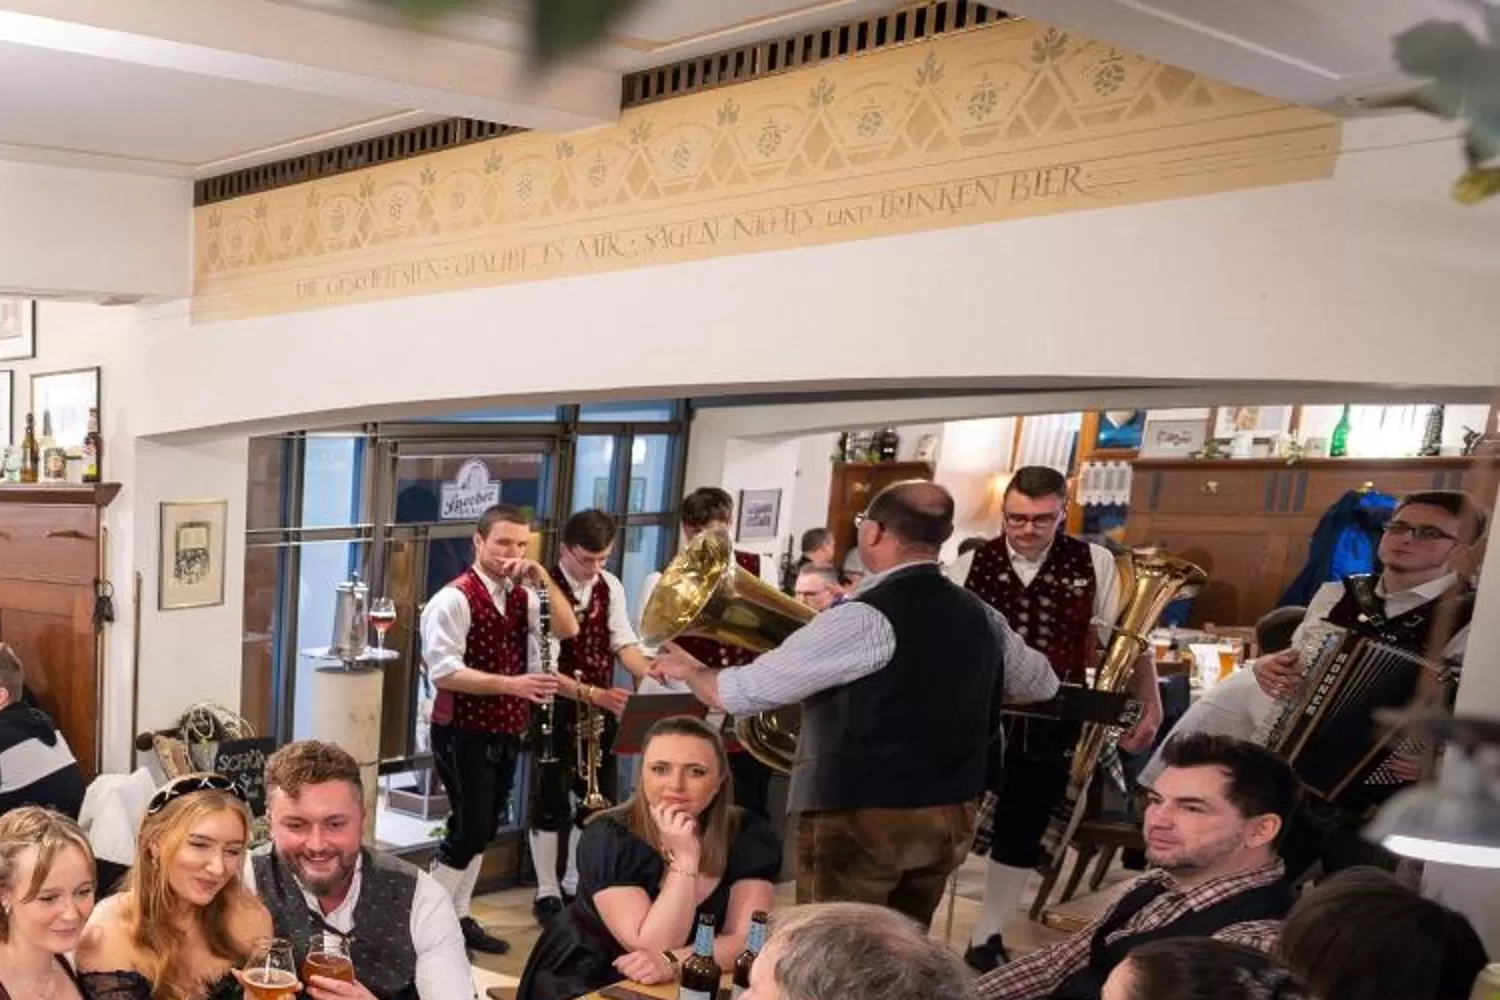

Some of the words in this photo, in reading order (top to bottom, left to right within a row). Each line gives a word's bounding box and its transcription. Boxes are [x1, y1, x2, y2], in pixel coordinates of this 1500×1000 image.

[642, 217, 720, 252] SAGEN
[879, 177, 999, 219] TRINKEN
[1010, 164, 1092, 202] BIER
